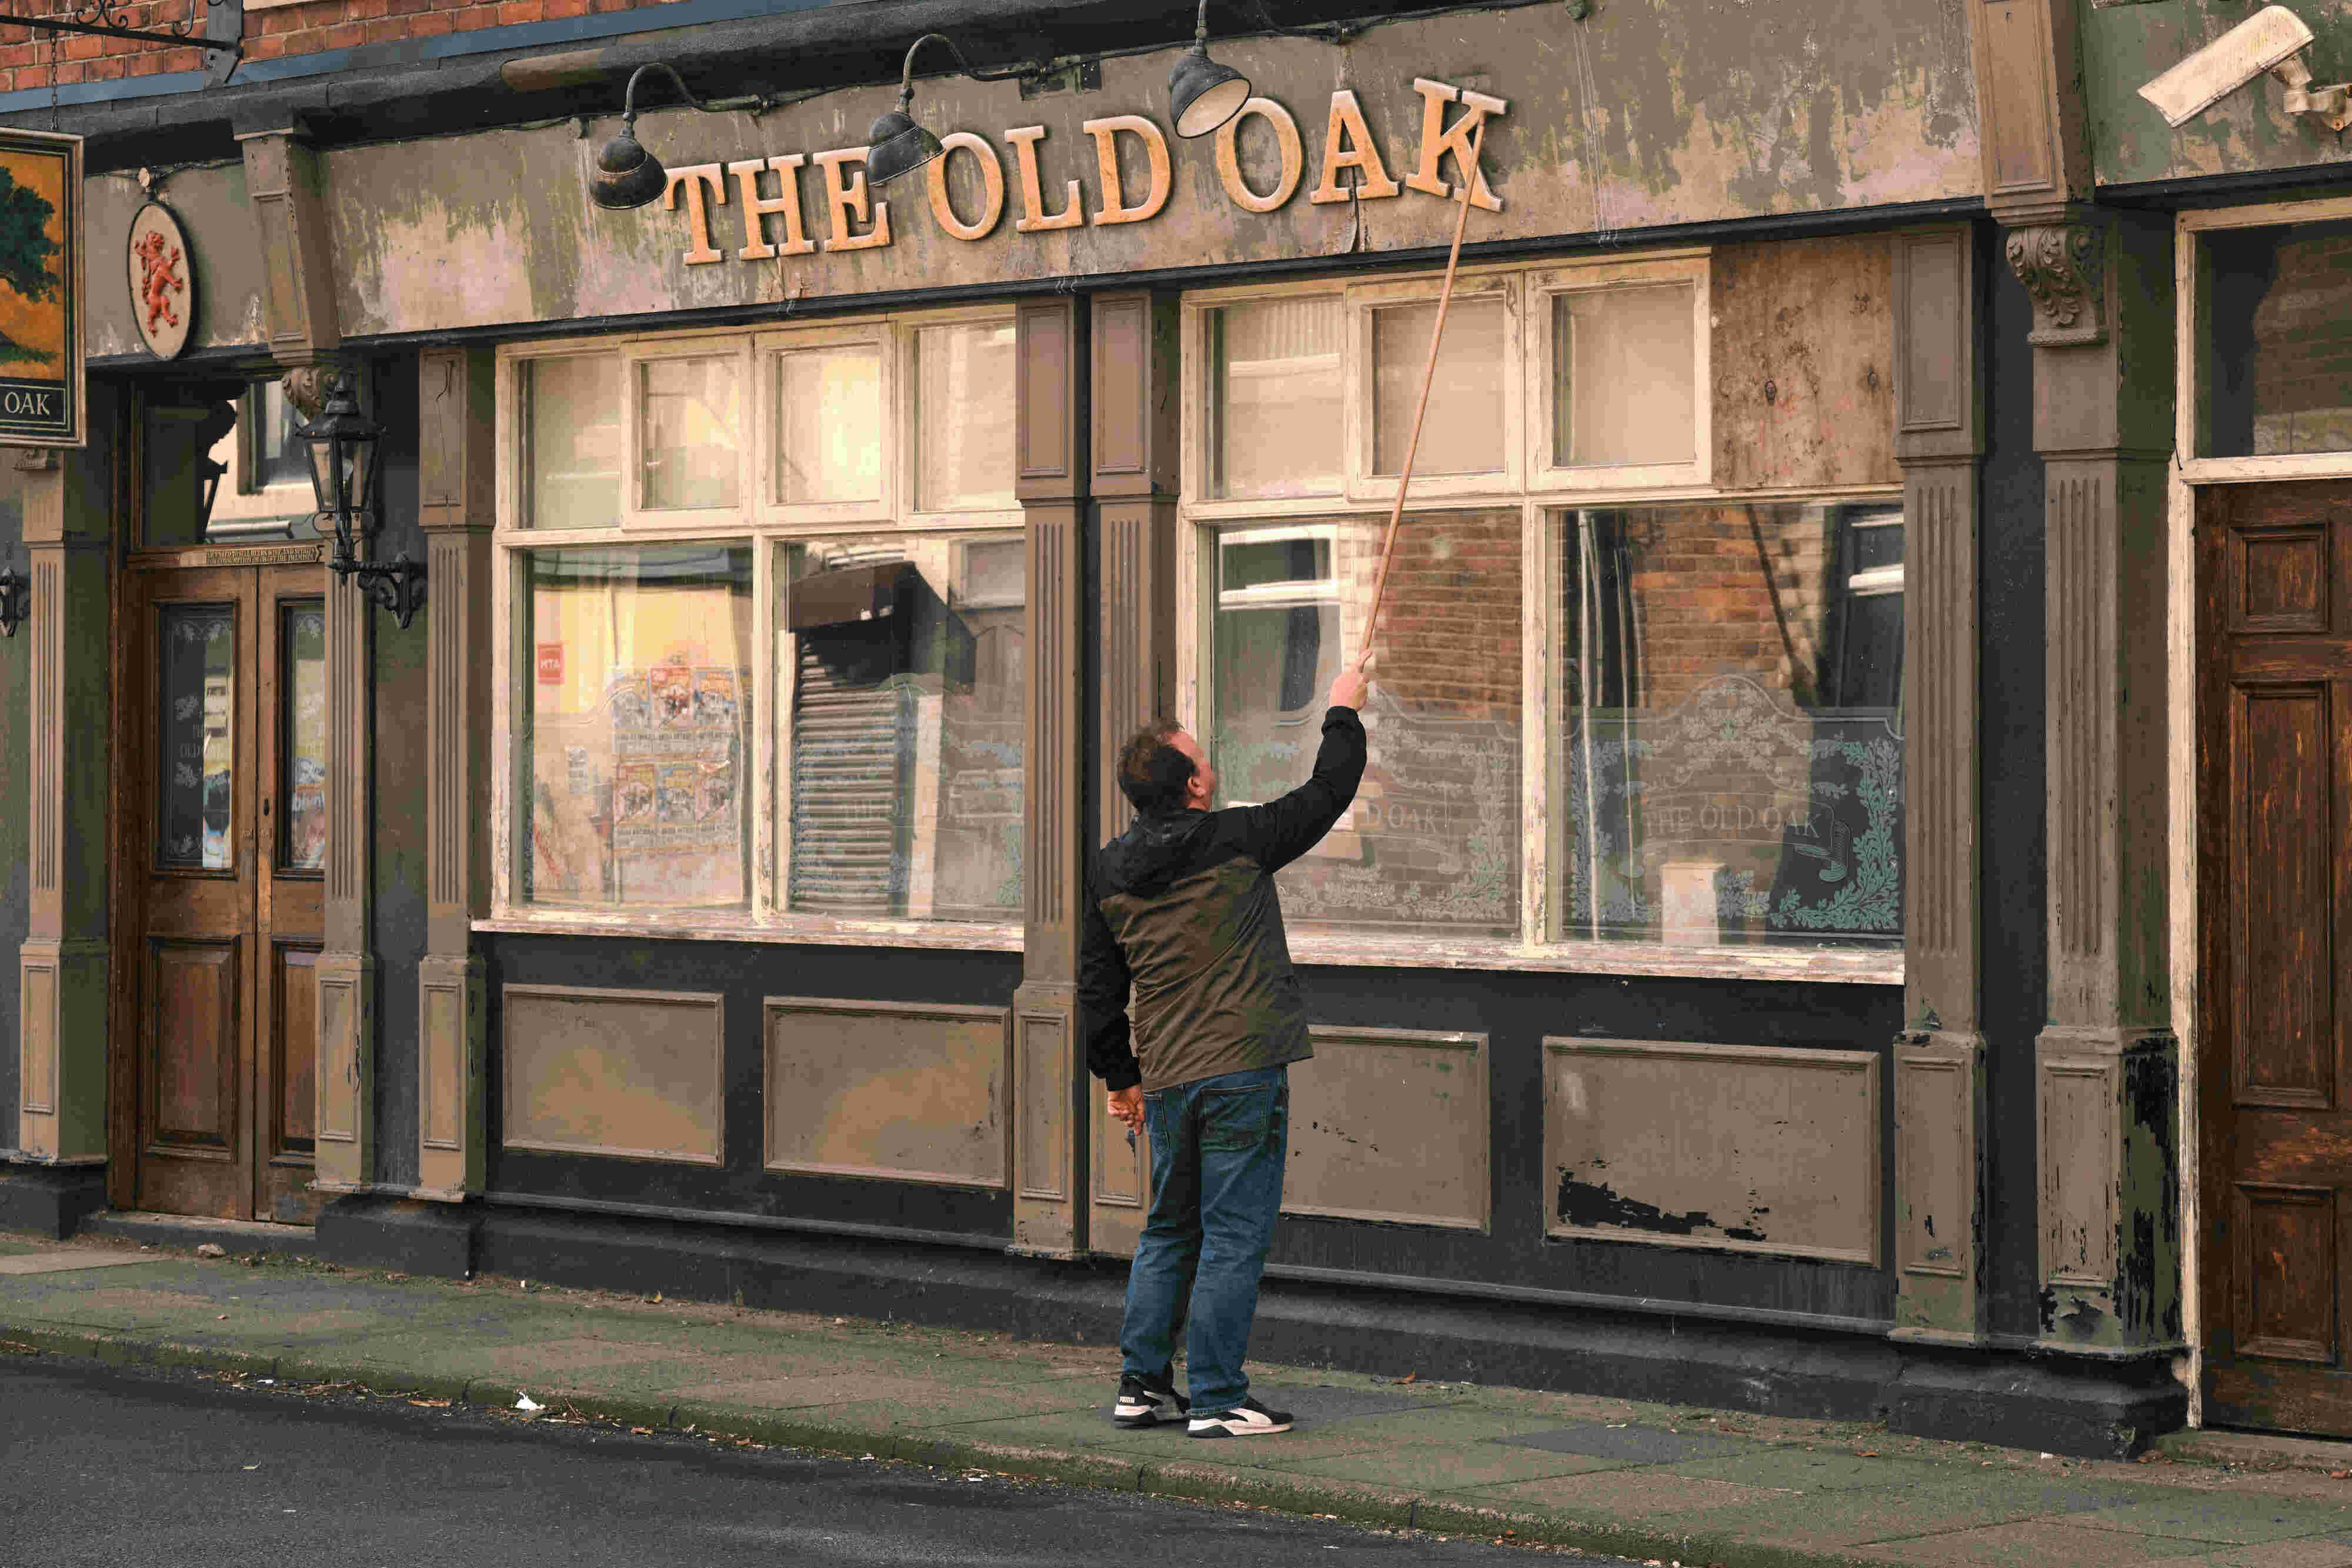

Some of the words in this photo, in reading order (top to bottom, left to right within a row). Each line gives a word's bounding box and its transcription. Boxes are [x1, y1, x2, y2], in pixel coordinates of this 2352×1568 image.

[665, 147, 891, 265] THE
[927, 114, 1172, 241] OLD
[1215, 77, 1509, 213] OAK
[5, 391, 50, 415] OAK
[1387, 804, 1437, 834] OAK
[1646, 806, 1694, 835] THE
[1699, 804, 1756, 833] OLD
[1762, 806, 1822, 839] OAK
